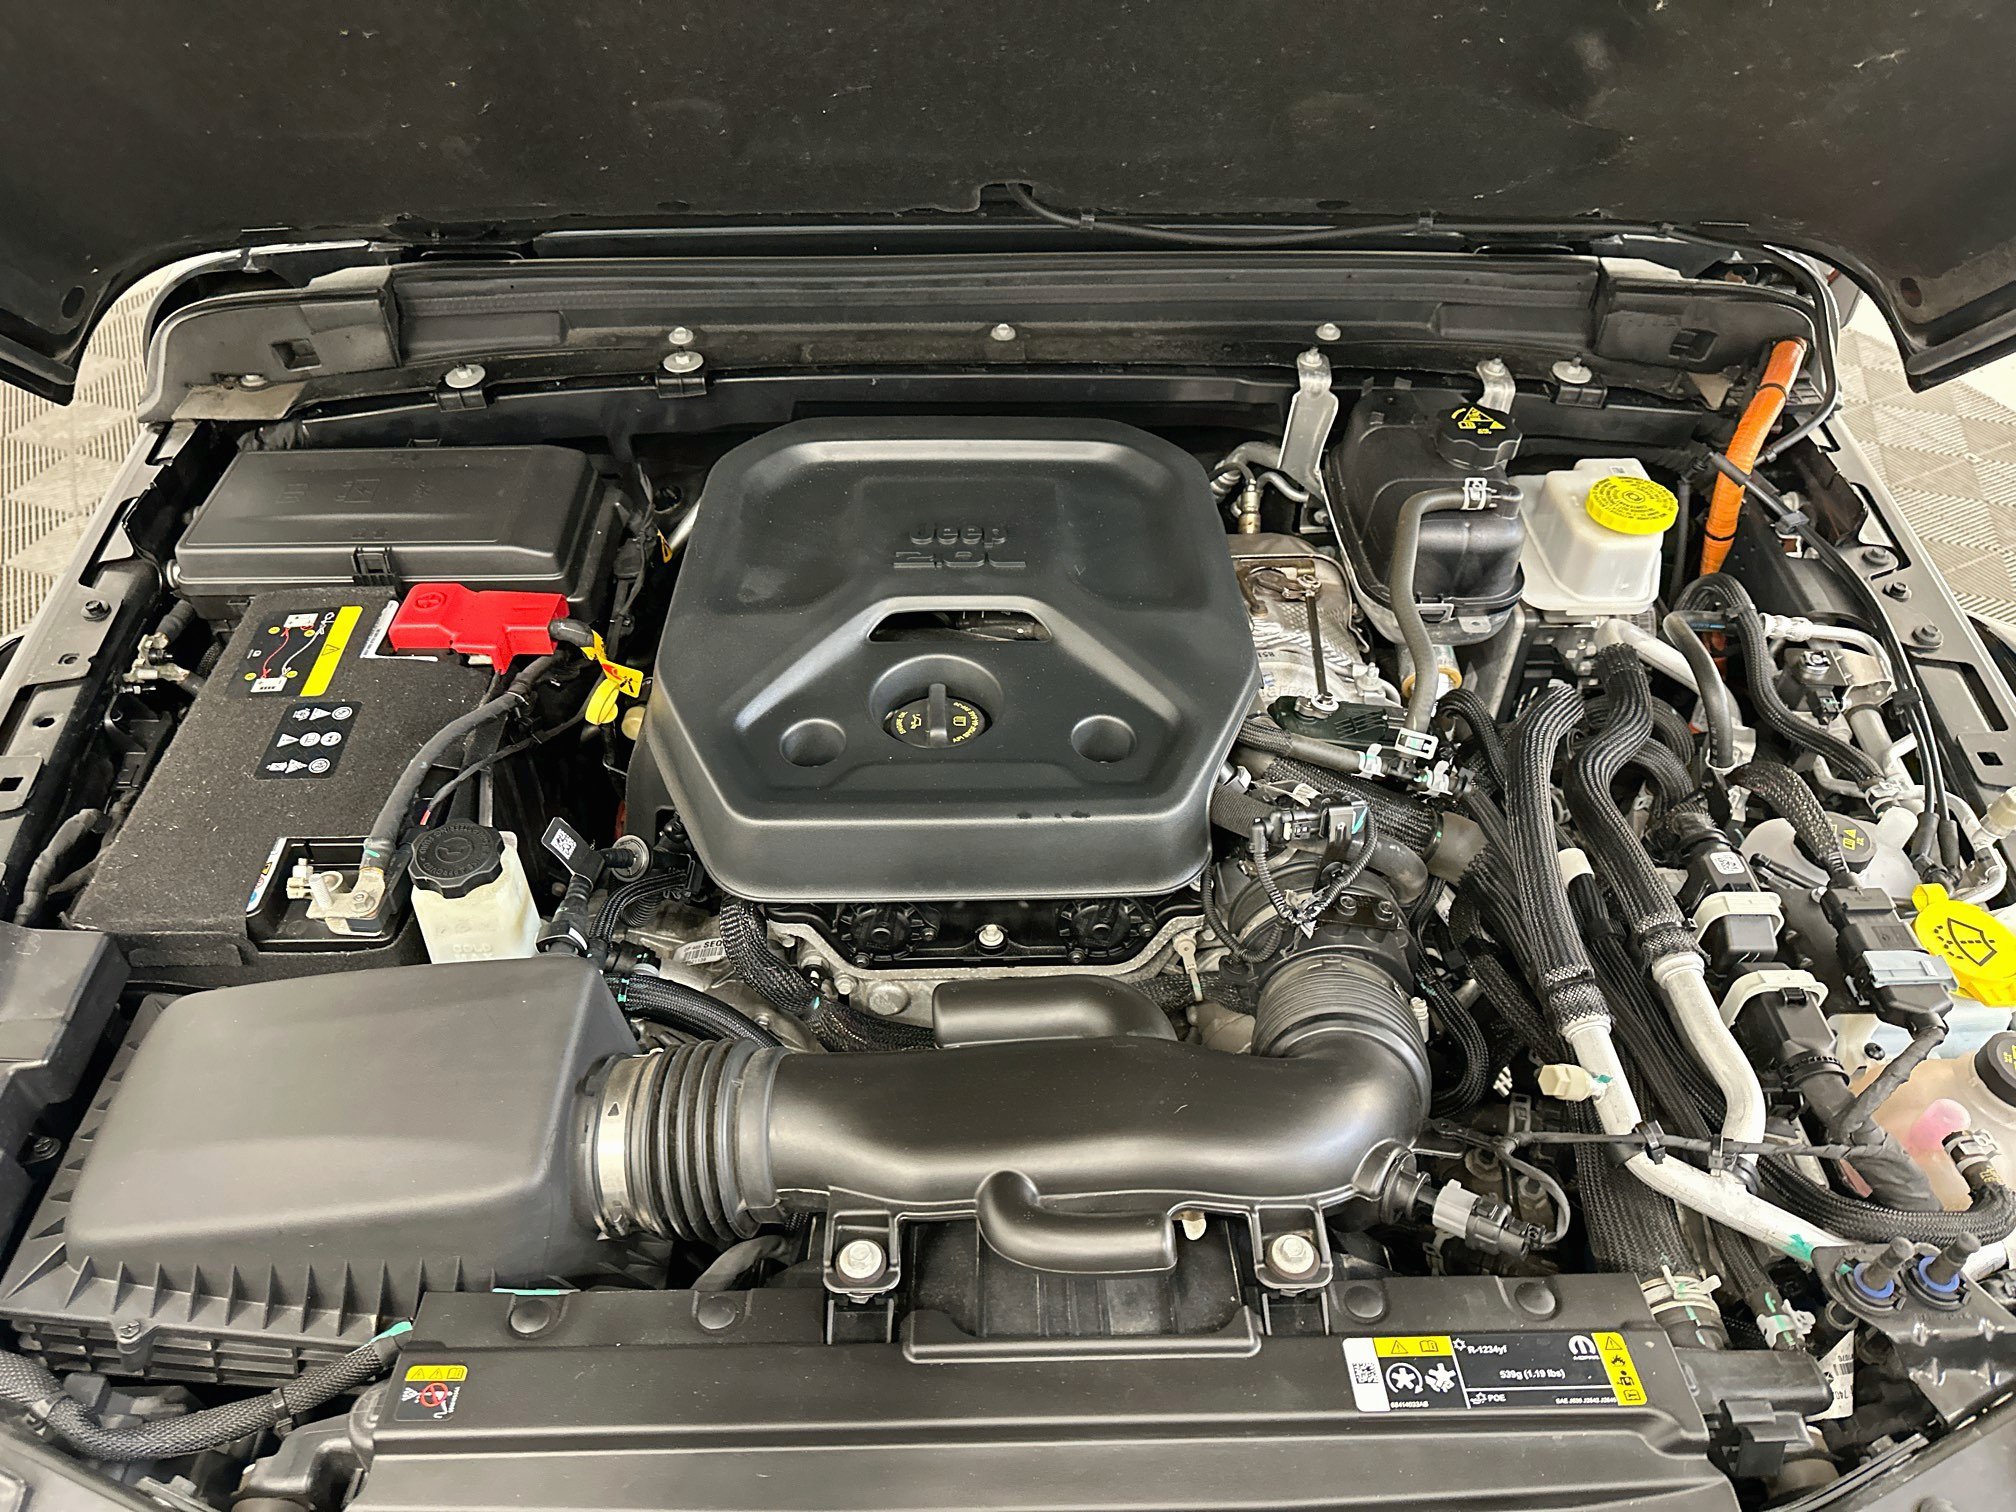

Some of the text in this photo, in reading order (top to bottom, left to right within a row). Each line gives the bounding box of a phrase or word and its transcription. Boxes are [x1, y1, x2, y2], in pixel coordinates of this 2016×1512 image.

[910, 522, 1006, 549] Jeep
[453, 944, 492, 953] COLD
[1499, 1370, 1523, 1380] 539g
[1488, 1394, 1507, 1402] POE
